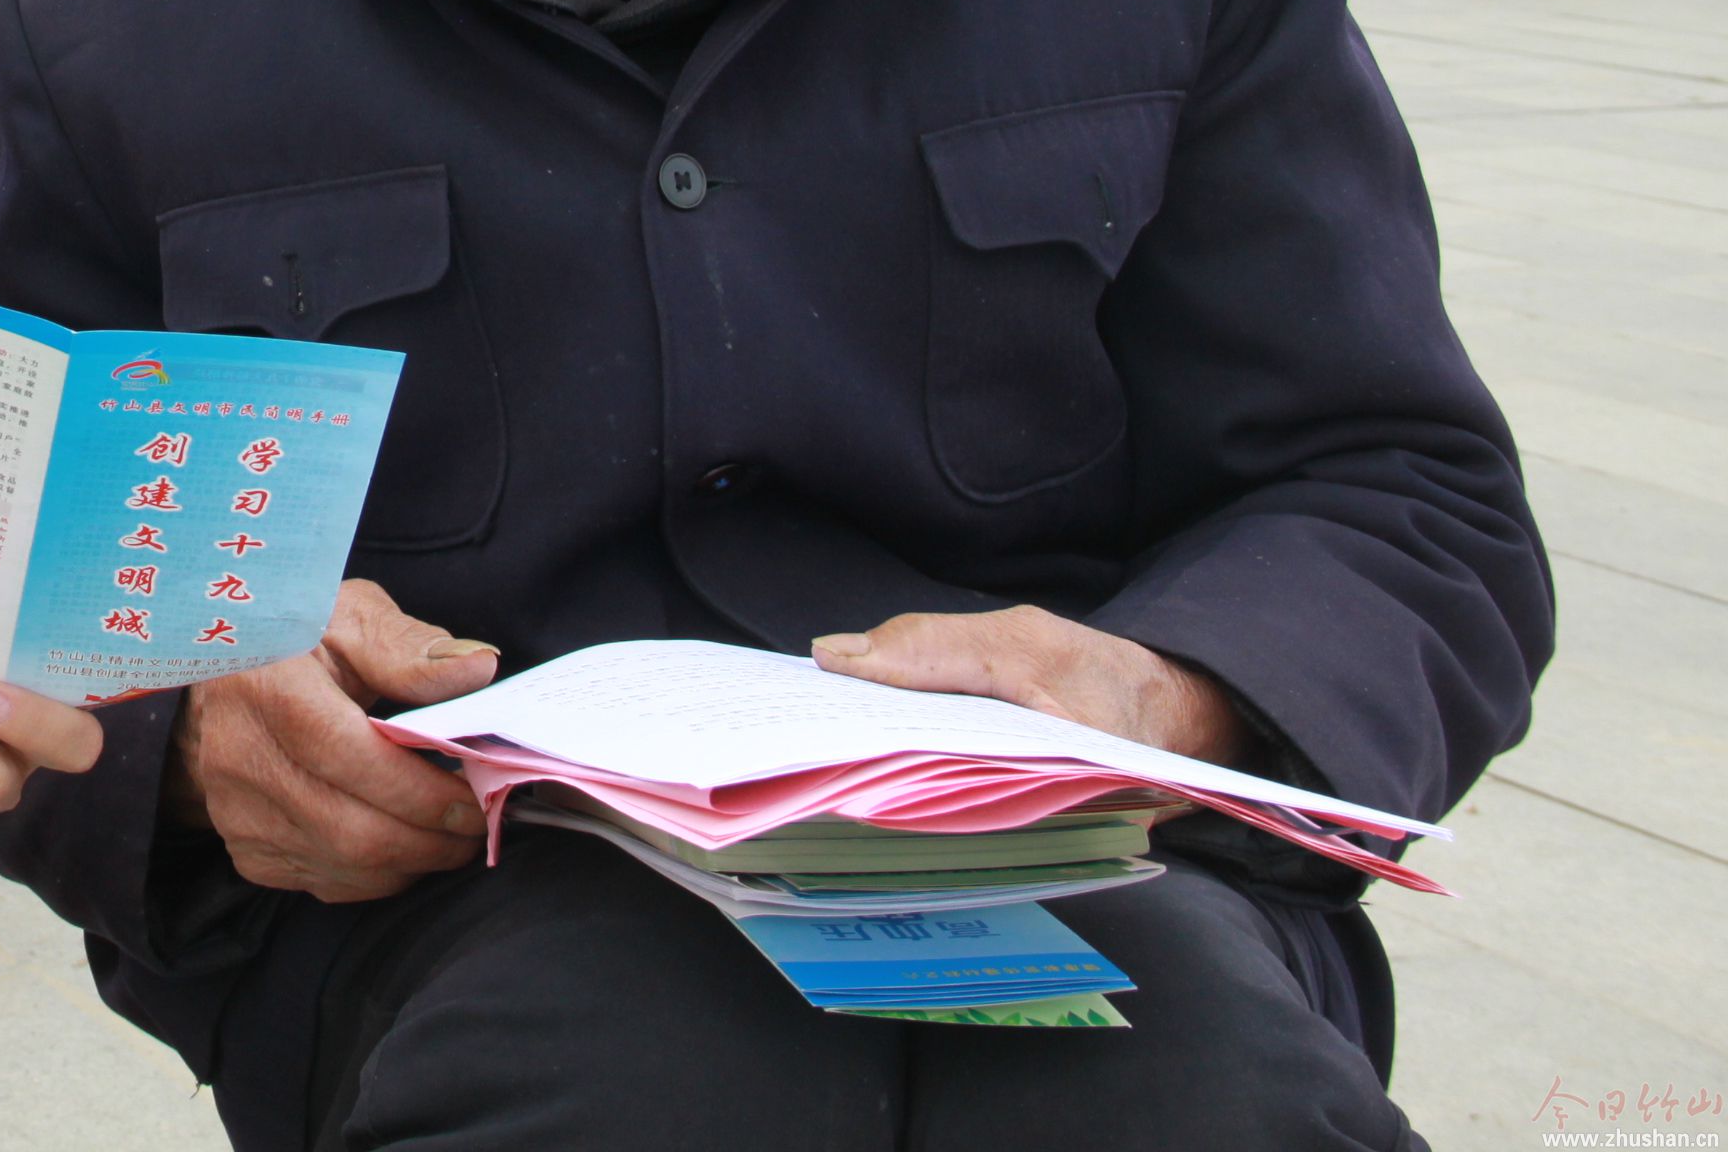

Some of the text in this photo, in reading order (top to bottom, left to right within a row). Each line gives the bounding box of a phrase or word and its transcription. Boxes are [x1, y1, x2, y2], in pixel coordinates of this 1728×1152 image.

[100, 398, 351, 426] 竹山县文明市民简明手册
[103, 434, 190, 642] 创建文明城
[196, 440, 282, 645] 学习十九大
[810, 919, 1001, 942] 高血压
